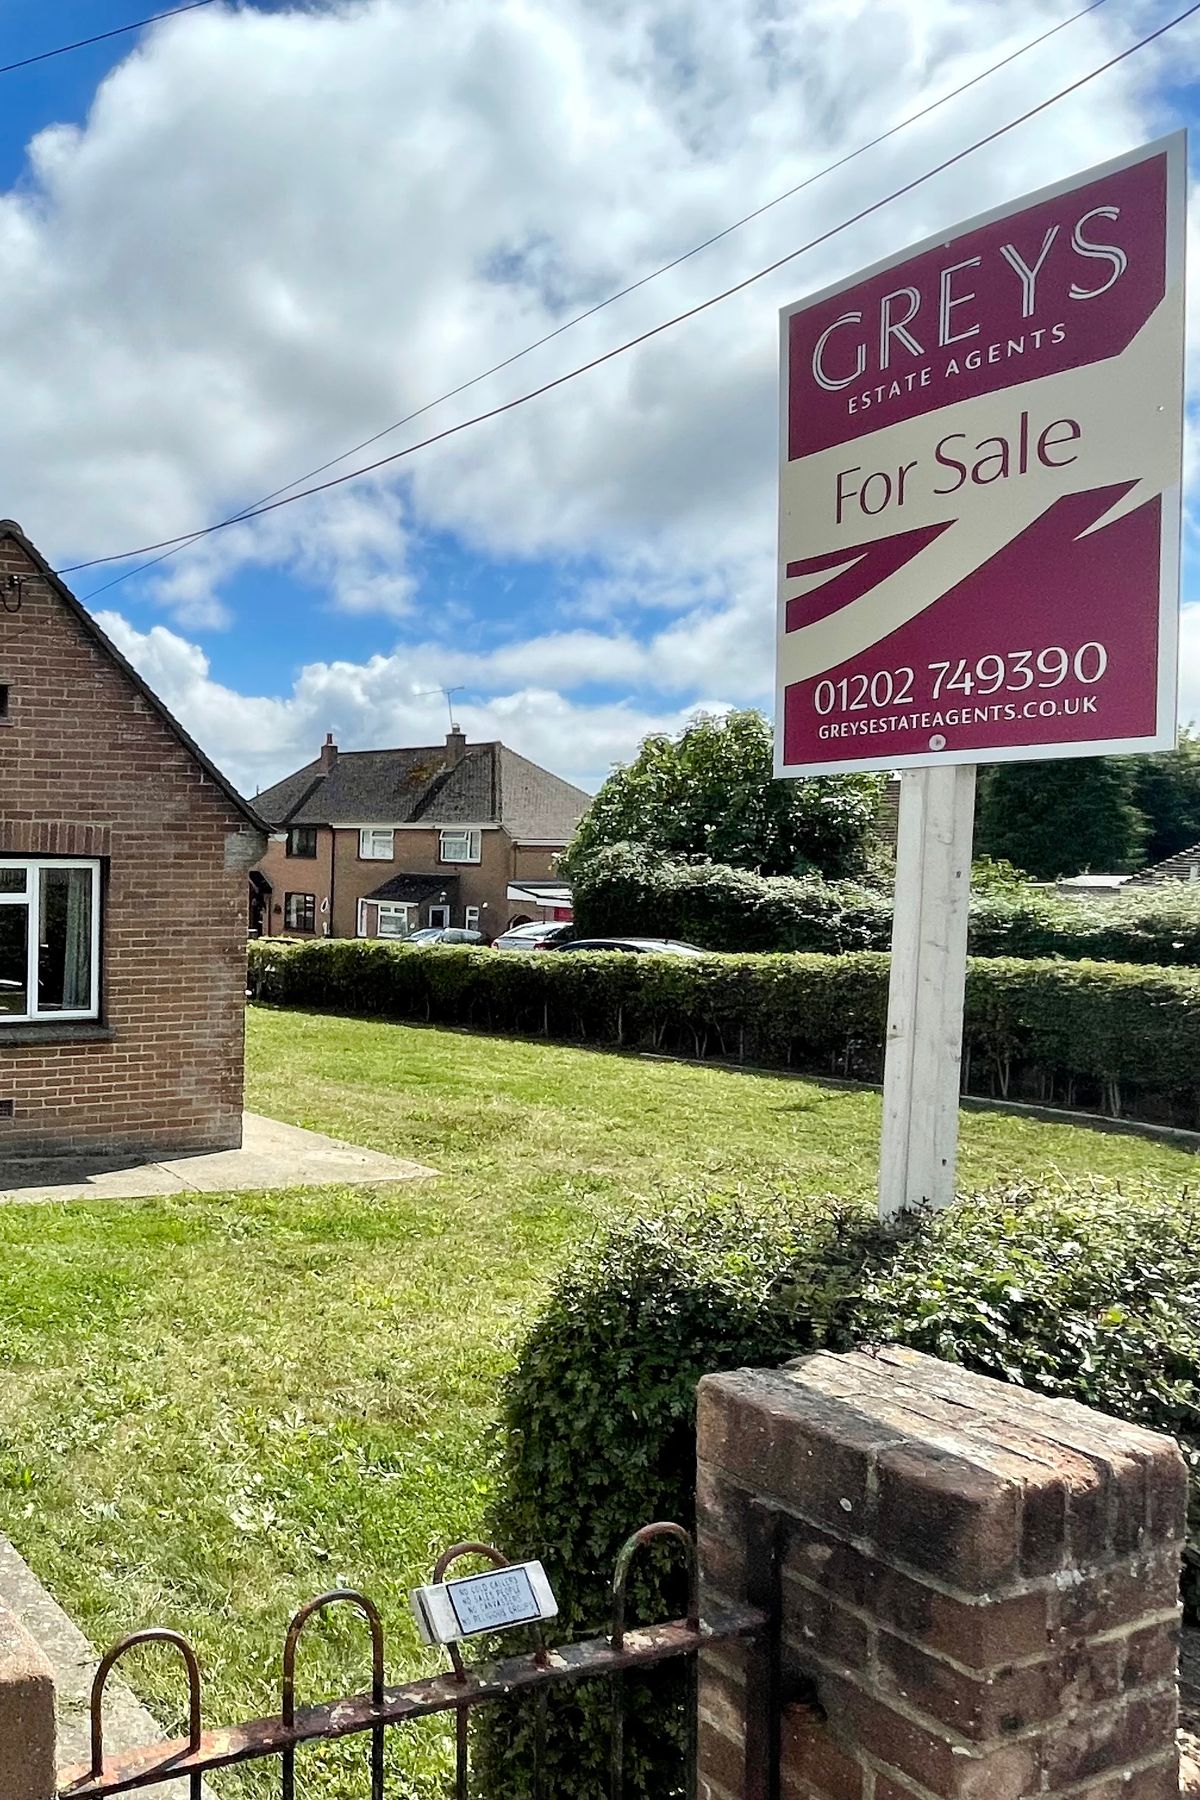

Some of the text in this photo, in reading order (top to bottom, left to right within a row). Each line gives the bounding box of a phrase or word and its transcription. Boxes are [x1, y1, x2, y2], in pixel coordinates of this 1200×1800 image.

[812, 205, 1129, 391] GREYS
[848, 323, 1067, 414] ESTATE AGENTS
[835, 411, 1082, 524] For Sale
[814, 641, 1109, 715] 01202 749390
[818, 696, 1099, 740] GREYSESTATEAGENTS.CO.UK
[459, 1576, 518, 1596] NO COLD CALLERS
[462, 1596, 471, 1605] NO
